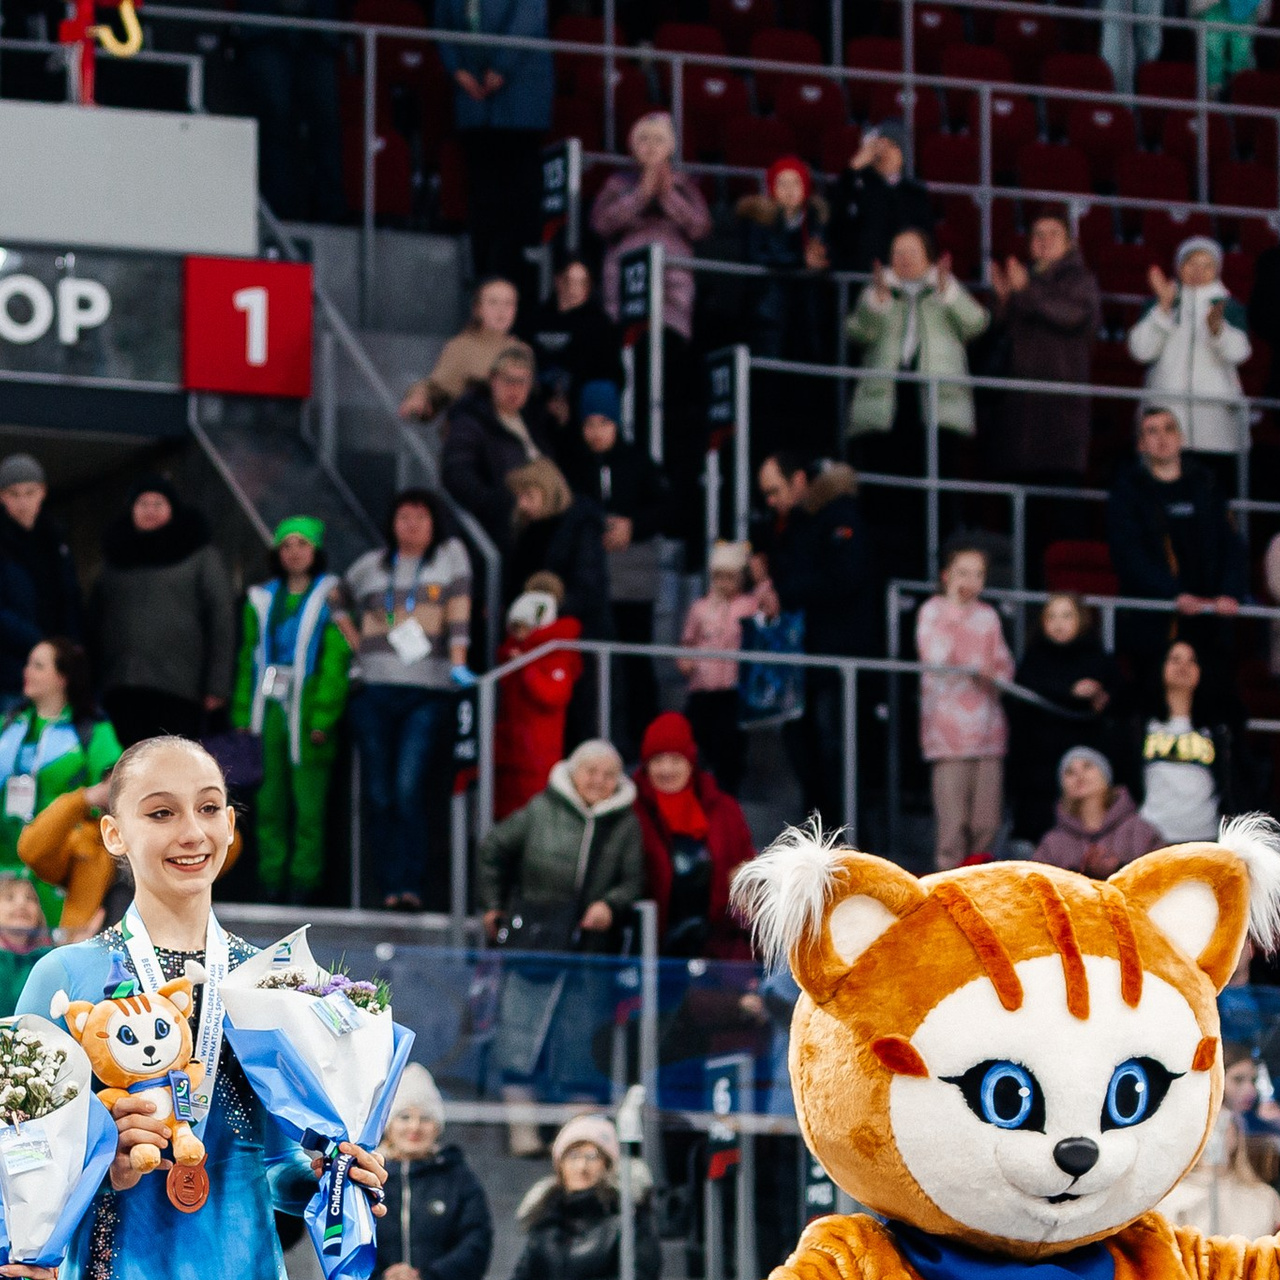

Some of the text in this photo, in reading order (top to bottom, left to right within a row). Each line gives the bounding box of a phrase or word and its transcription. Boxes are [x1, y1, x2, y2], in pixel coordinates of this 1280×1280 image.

[232, 286, 269, 366] 1
[141, 957, 159, 992] BEGINN
[200, 1025, 210, 1058] WINTER
[205, 988, 215, 1024] CHILDREN
[205, 1012, 220, 1077] INTERNATIONAL
[713, 1076, 732, 1116] 6
[330, 1171, 344, 1216] Children
